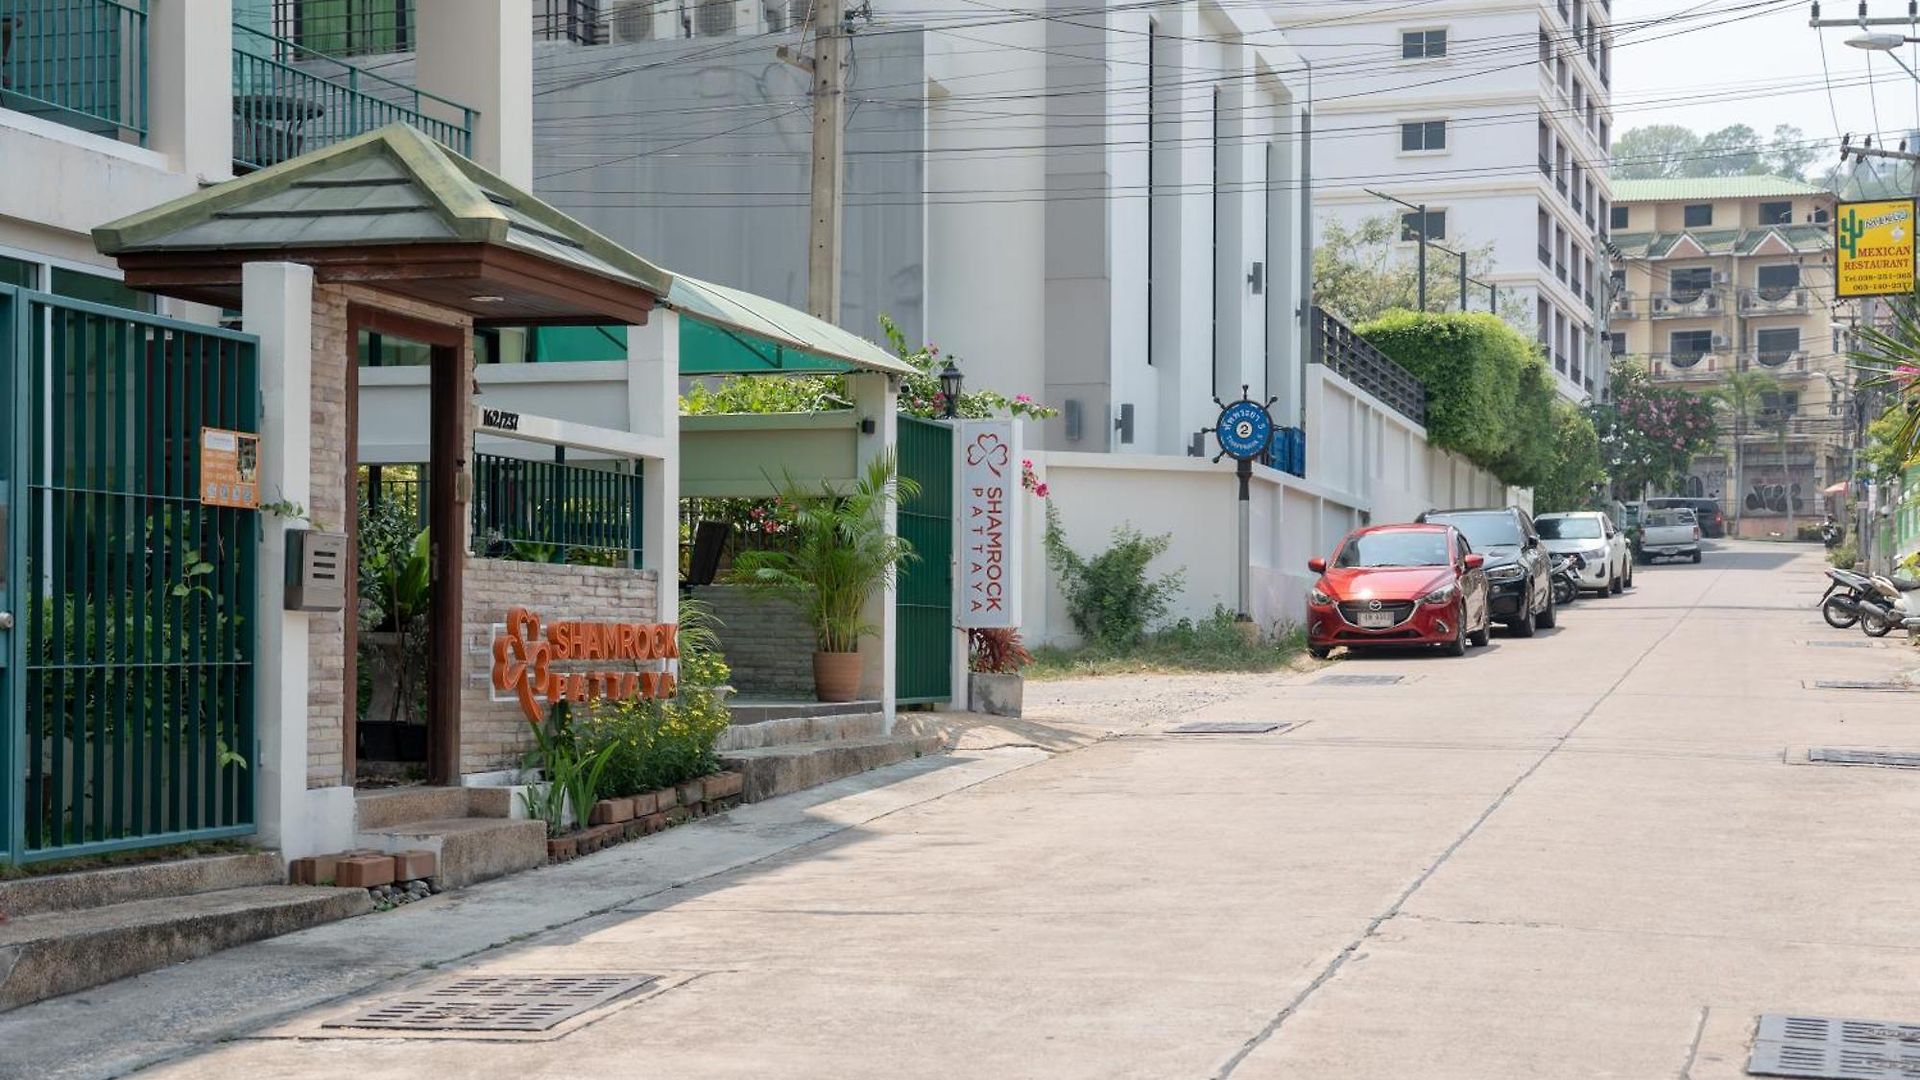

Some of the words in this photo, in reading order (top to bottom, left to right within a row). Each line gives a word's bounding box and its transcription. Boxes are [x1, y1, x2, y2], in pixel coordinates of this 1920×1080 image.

[1843, 258, 1909, 271] RESTAURANT
[1857, 245, 1911, 258] MEXICAN
[1240, 424, 1249, 434] 2
[971, 487, 984, 612] PATTAYA
[986, 486, 1003, 612] SHAMROCK
[547, 621, 679, 659] SHAMROCK
[547, 671, 677, 704] PATTAYA
